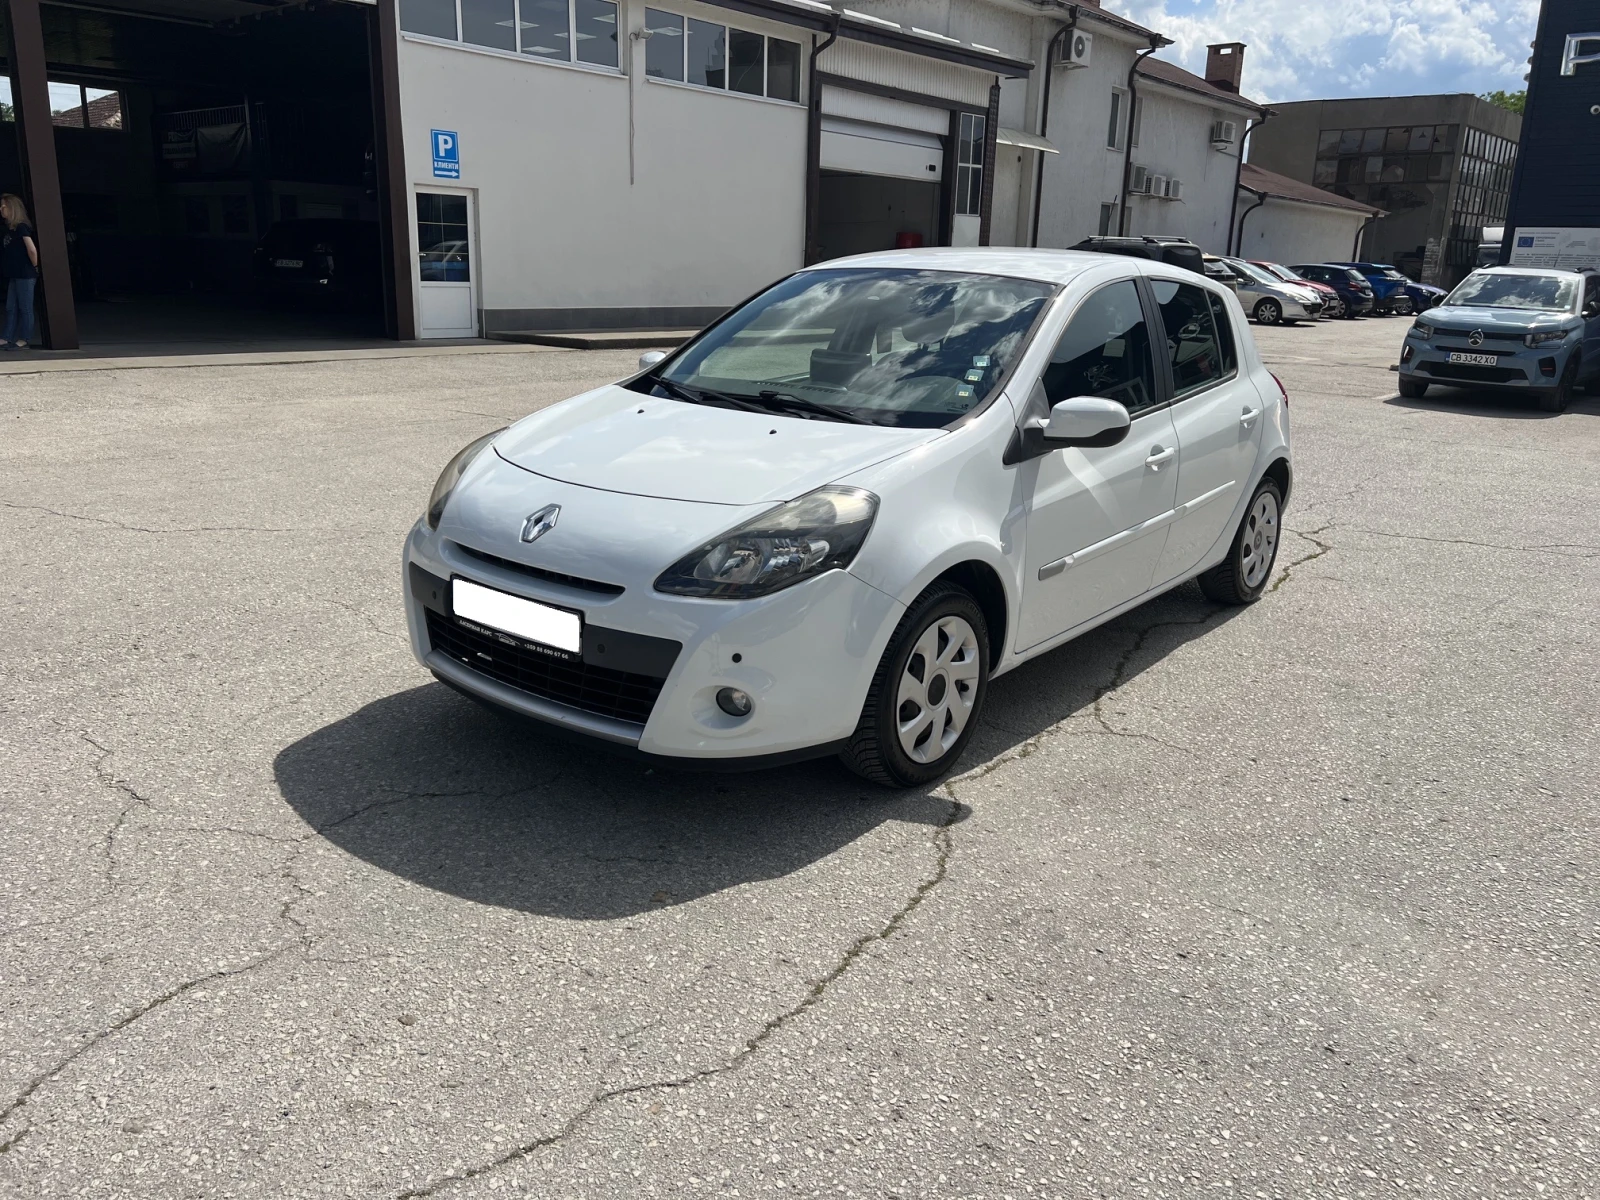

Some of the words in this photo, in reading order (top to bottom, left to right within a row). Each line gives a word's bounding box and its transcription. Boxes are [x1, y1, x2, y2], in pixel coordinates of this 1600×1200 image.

[438, 134, 453, 157] P
[433, 161, 459, 170] КЛИЕНТИ
[1462, 354, 1483, 364] 3342
